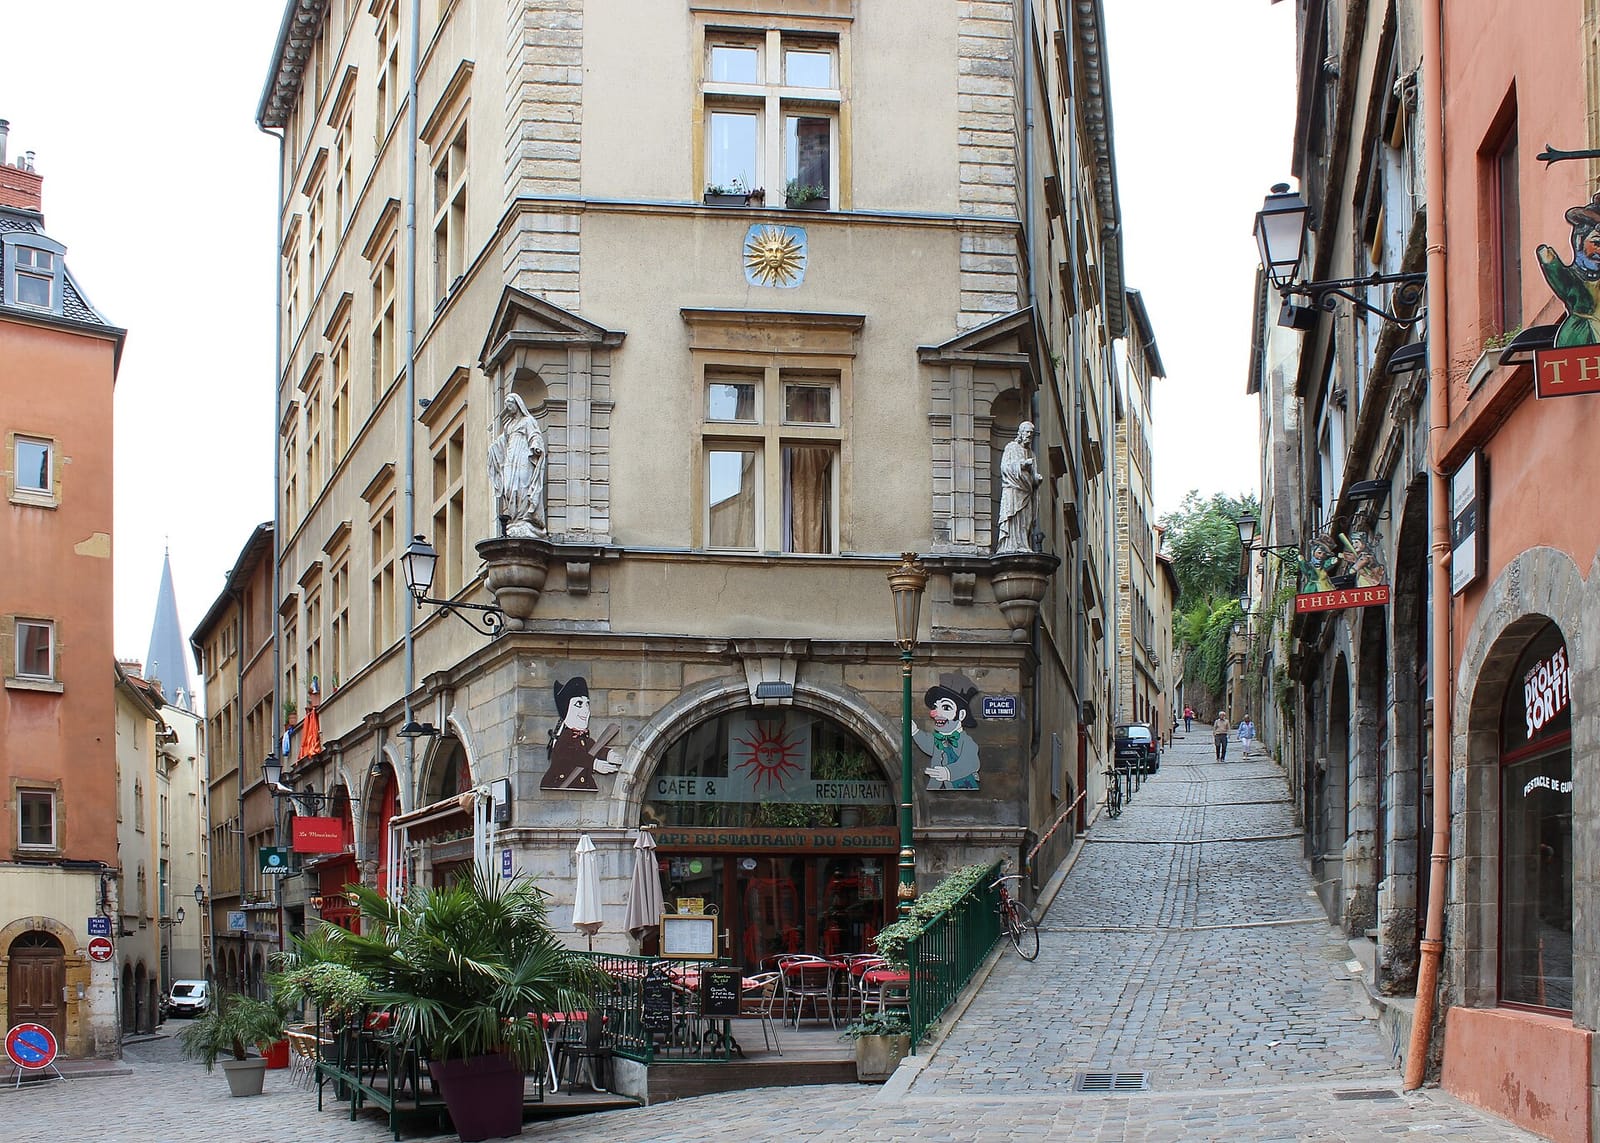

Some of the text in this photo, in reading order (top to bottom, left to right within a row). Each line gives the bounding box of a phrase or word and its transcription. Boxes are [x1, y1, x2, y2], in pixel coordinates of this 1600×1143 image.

[1297, 590, 1386, 608] THÉÂTRE
[658, 780, 888, 799] CAFE & RESTAURANT
[1523, 775, 1550, 798] PESTACLE
[1551, 778, 1560, 791] DE
[654, 833, 896, 848] AFE RESTAURANT DU SOLEIL
[262, 865, 288, 874] Laverie
